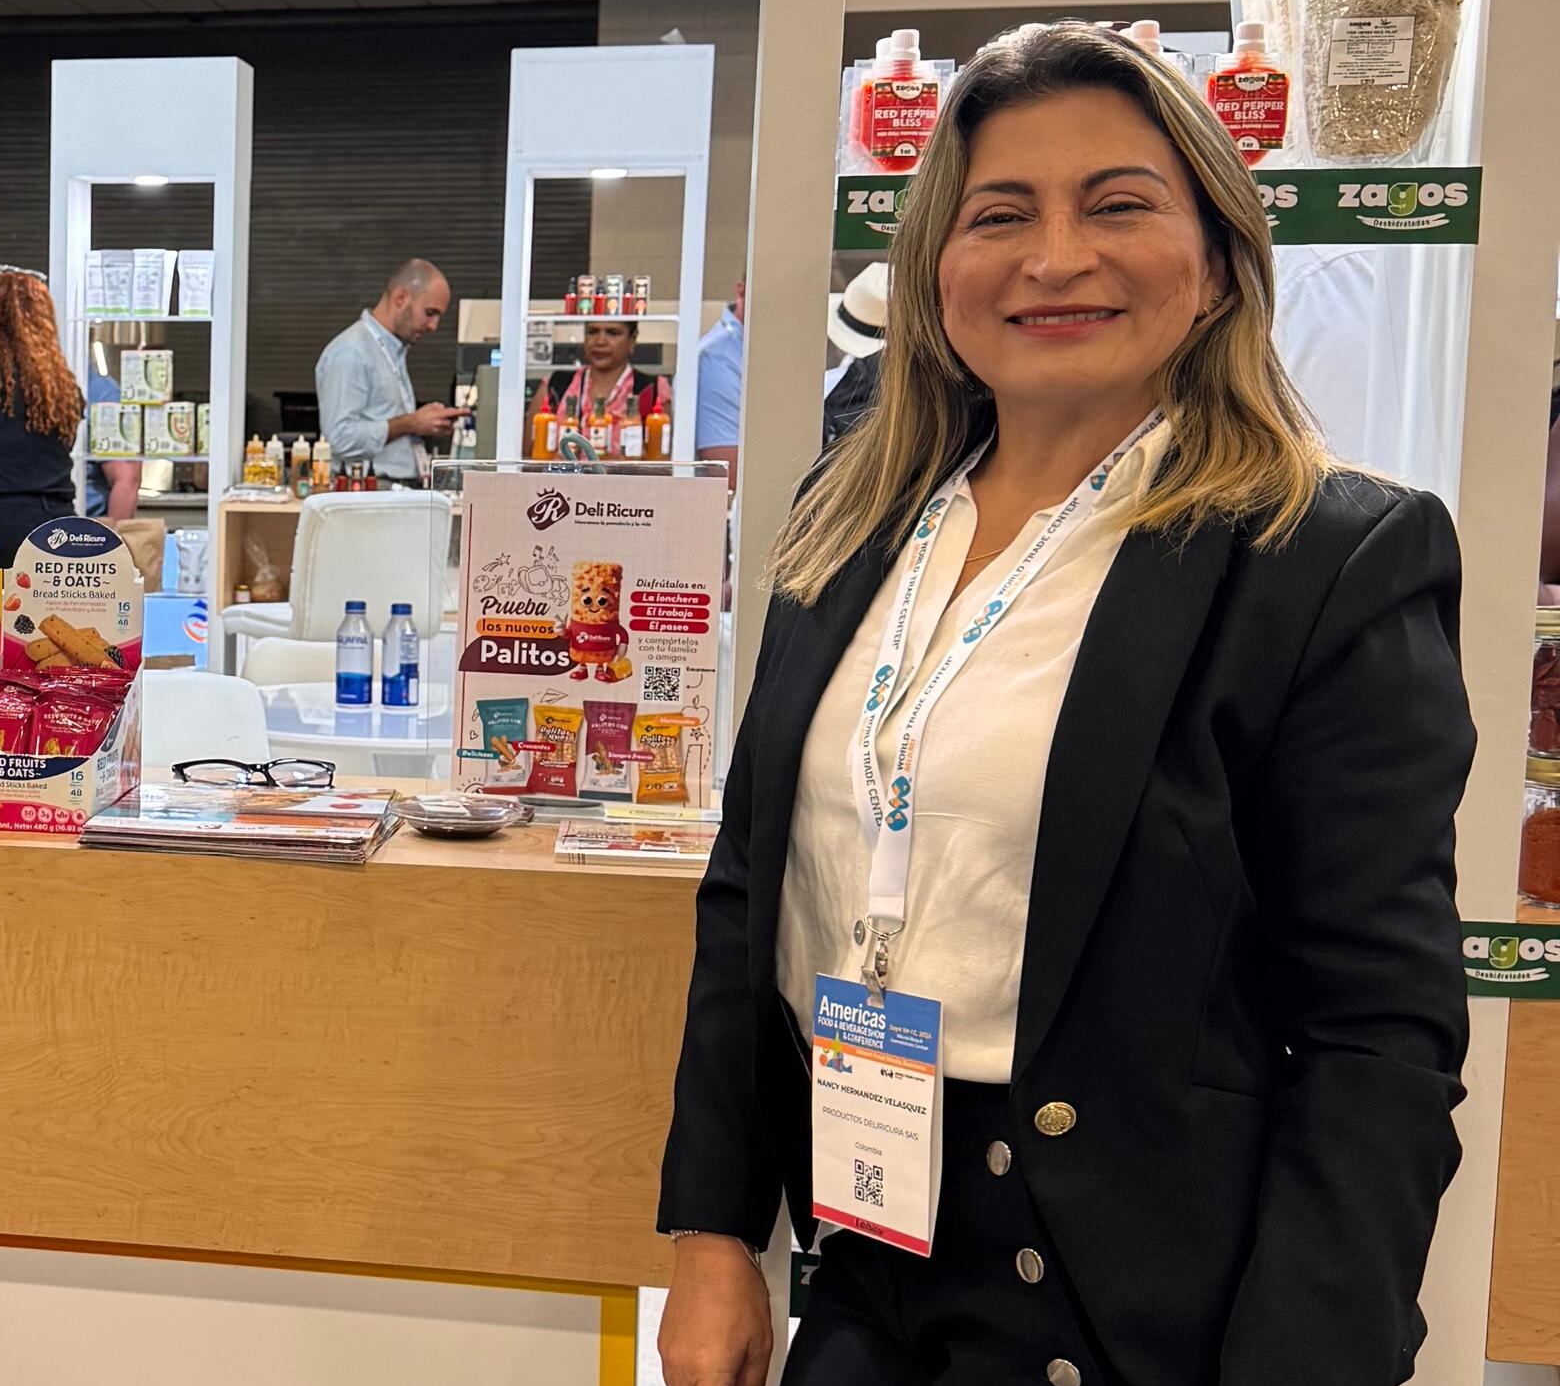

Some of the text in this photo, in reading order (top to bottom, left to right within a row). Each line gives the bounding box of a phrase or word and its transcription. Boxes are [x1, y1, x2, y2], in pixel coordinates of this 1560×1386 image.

[1216, 100, 1285, 112] RED PEPPER
[875, 108, 938, 120] RED PEPPER
[1234, 110, 1266, 120] BLISS
[892, 118, 922, 127] BLISS
[1337, 181, 1469, 217] zagos
[1372, 218, 1431, 228] Deshidratados
[575, 501, 654, 518] Deli Ricura
[35, 562, 117, 575] RED FRUITS
[996, 535, 1050, 597] WORLD TRADE
[64, 576, 101, 588] OATS
[636, 578, 689, 590] Disfrútalos
[32, 589, 116, 600] Bread Sticks Baked
[642, 593, 699, 604] La lonchera
[118, 601, 131, 612] 16
[480, 595, 551, 617] Prueba
[646, 607, 694, 621] El trabajo
[482, 618, 555, 634] los nuevos
[648, 621, 690, 633] El paseo
[480, 639, 570, 667] Palitos
[655, 653, 687, 663] amigos
[896, 697, 927, 771] WORLD TRADE
[8, 757, 47, 769] FRUITS
[7, 768, 36, 779] OATS
[70, 770, 84, 782] 16
[819, 995, 887, 1030] Americas
[817, 1015, 834, 1028] FOOD
[817, 1078, 927, 1115] NANCY HERNANDEZ VELASQUEZ
[822, 1105, 863, 1125] PRODUCTOS
[854, 1141, 883, 1156] Colombia
